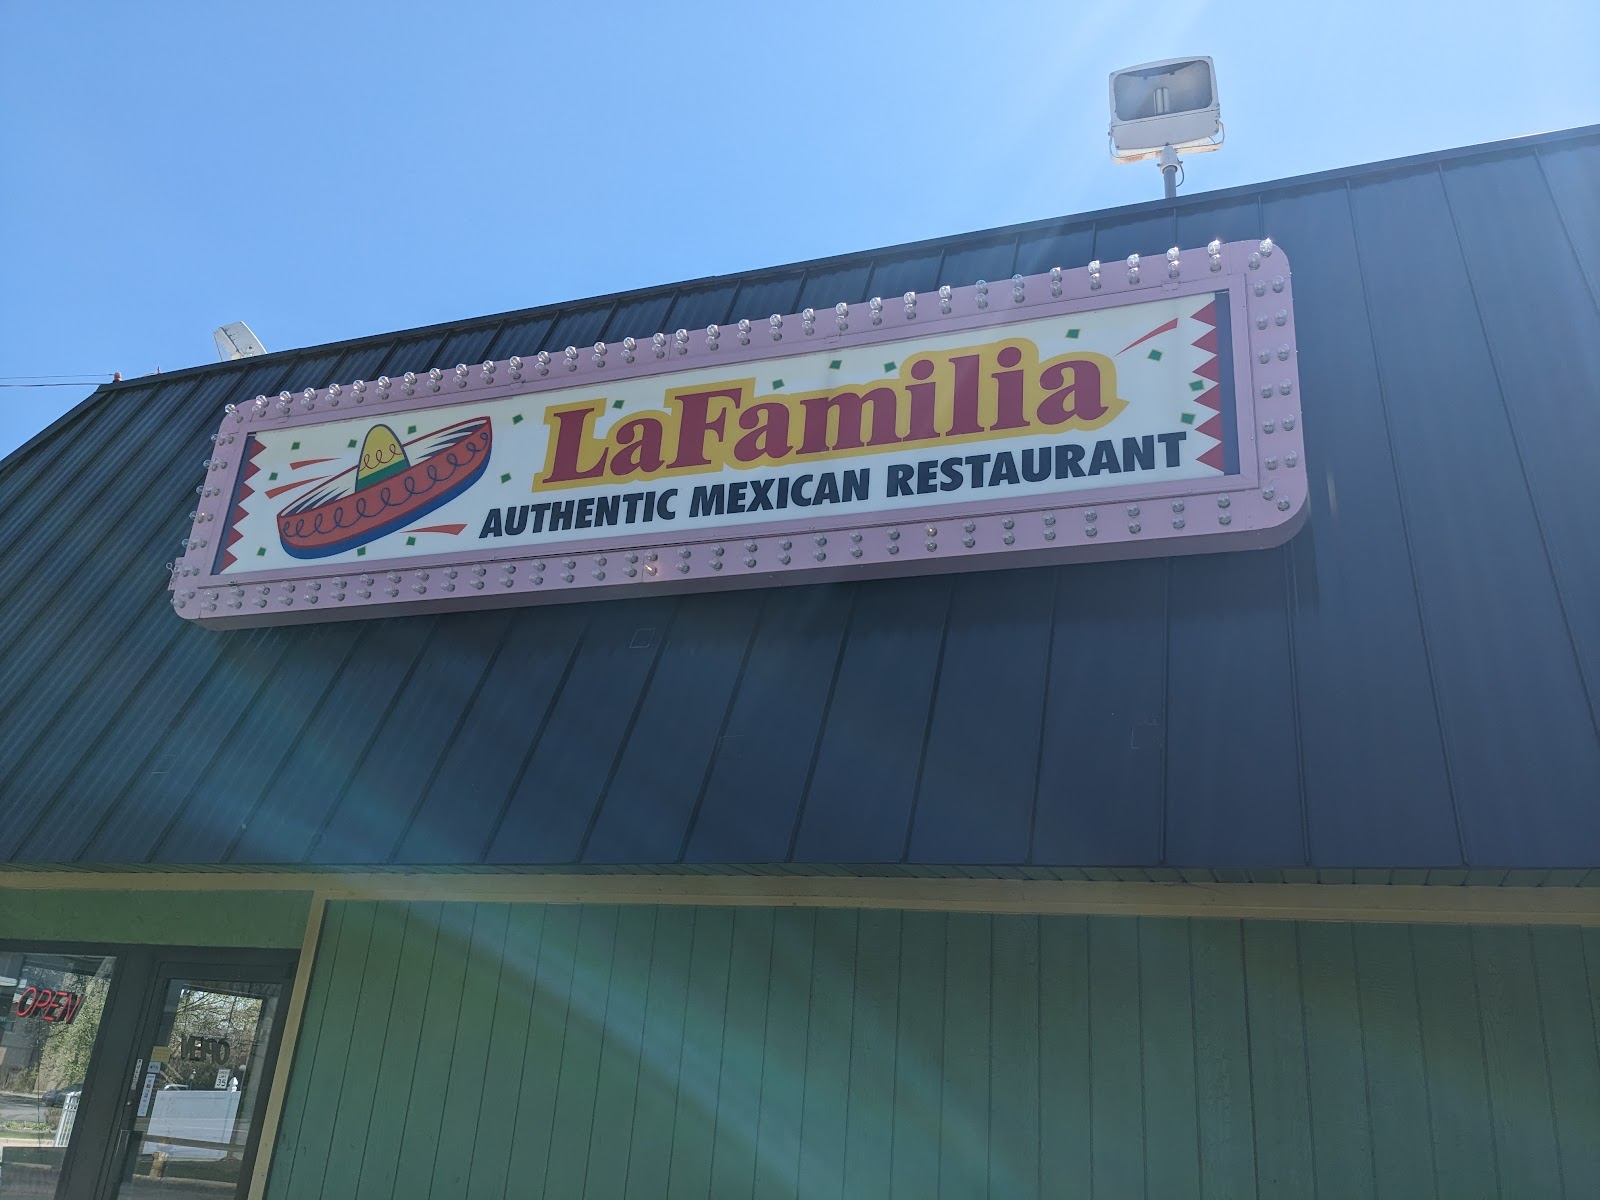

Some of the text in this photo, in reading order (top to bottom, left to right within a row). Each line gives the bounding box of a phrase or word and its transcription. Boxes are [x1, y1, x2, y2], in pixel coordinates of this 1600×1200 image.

[478, 431, 1188, 539] AUTHENTIC MEXICAN RESTAURANT
[16, 986, 83, 1023] OPEN
[216, 1078, 227, 1087] 35
